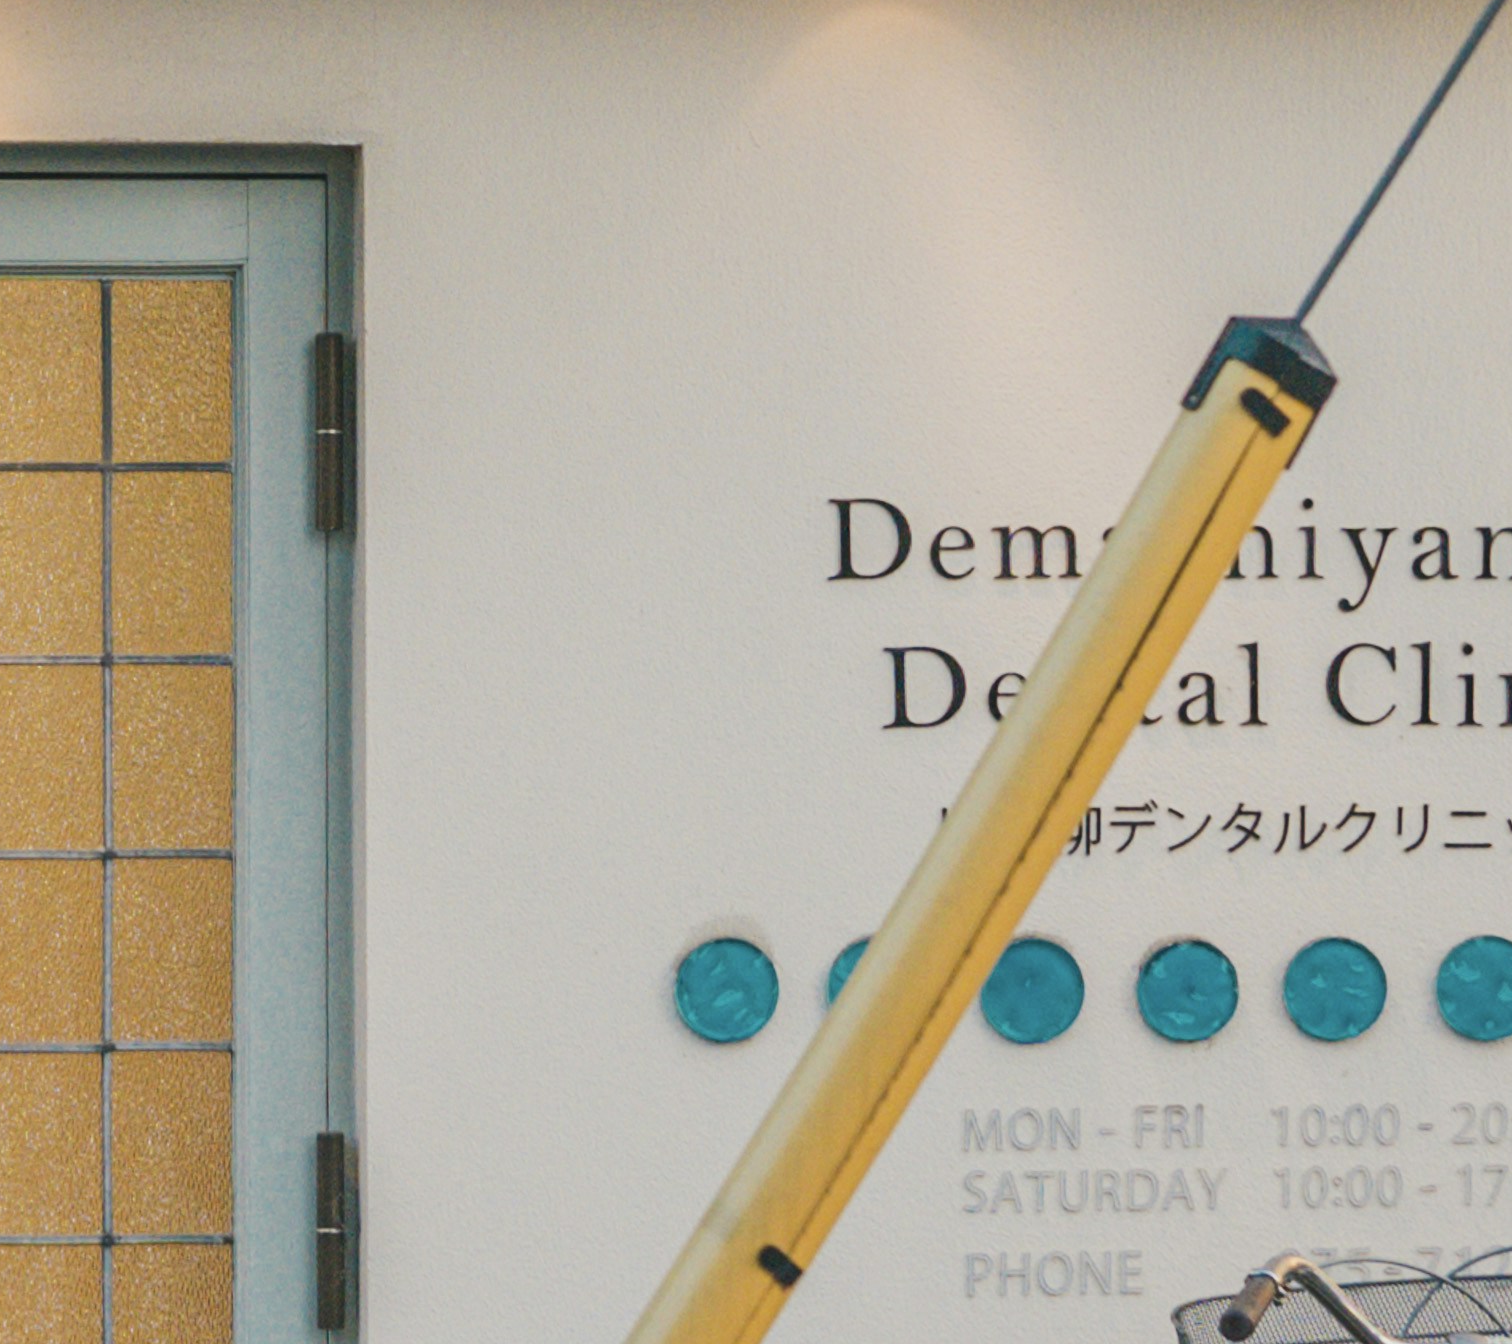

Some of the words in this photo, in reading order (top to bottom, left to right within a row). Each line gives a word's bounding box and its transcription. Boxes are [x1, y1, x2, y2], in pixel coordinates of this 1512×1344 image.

[882, 641, 1269, 731] Deal
[960, 1107, 1084, 1153] MON
[1132, 1103, 1206, 1150] FRI
[1270, 1102, 1401, 1148] 10:00
[962, 1168, 1225, 1213] SATURDAY
[1272, 1165, 1405, 1211] 10:00
[964, 1250, 1142, 1297] PHONE
